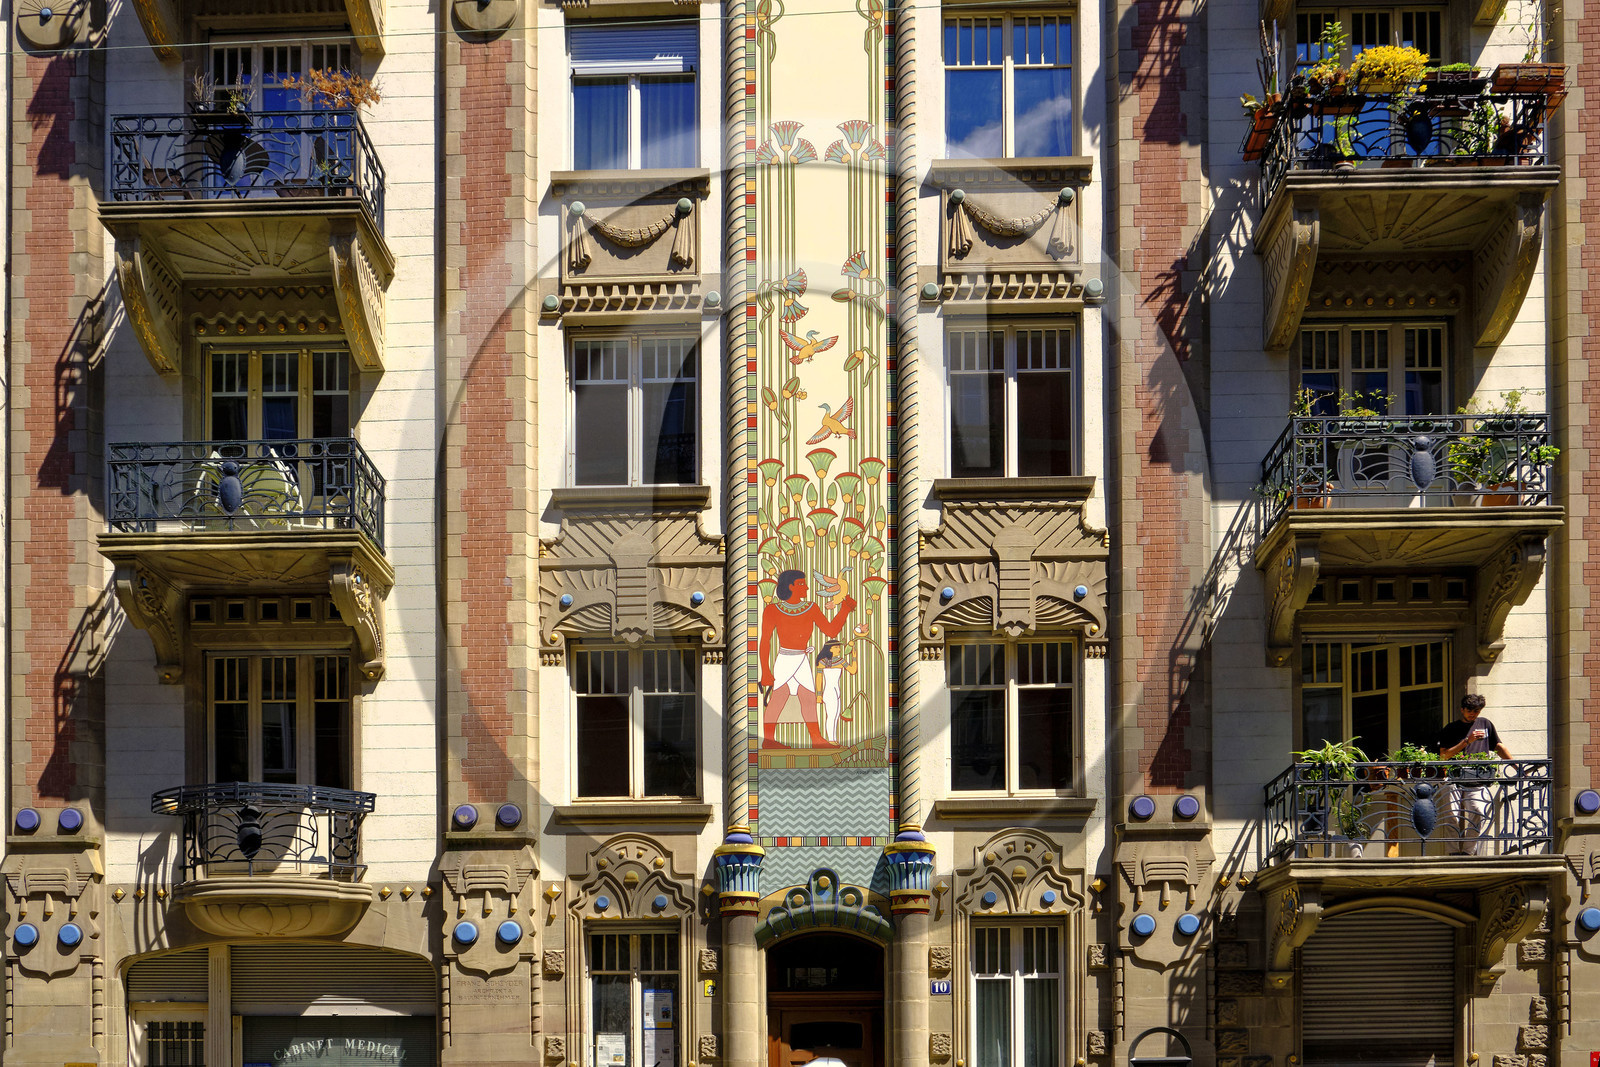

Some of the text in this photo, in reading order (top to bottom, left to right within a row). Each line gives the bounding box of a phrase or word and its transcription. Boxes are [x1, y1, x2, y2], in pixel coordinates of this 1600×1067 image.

[934, 982, 947, 992] 10
[273, 1038, 407, 1061] CABINET MEDICAL
